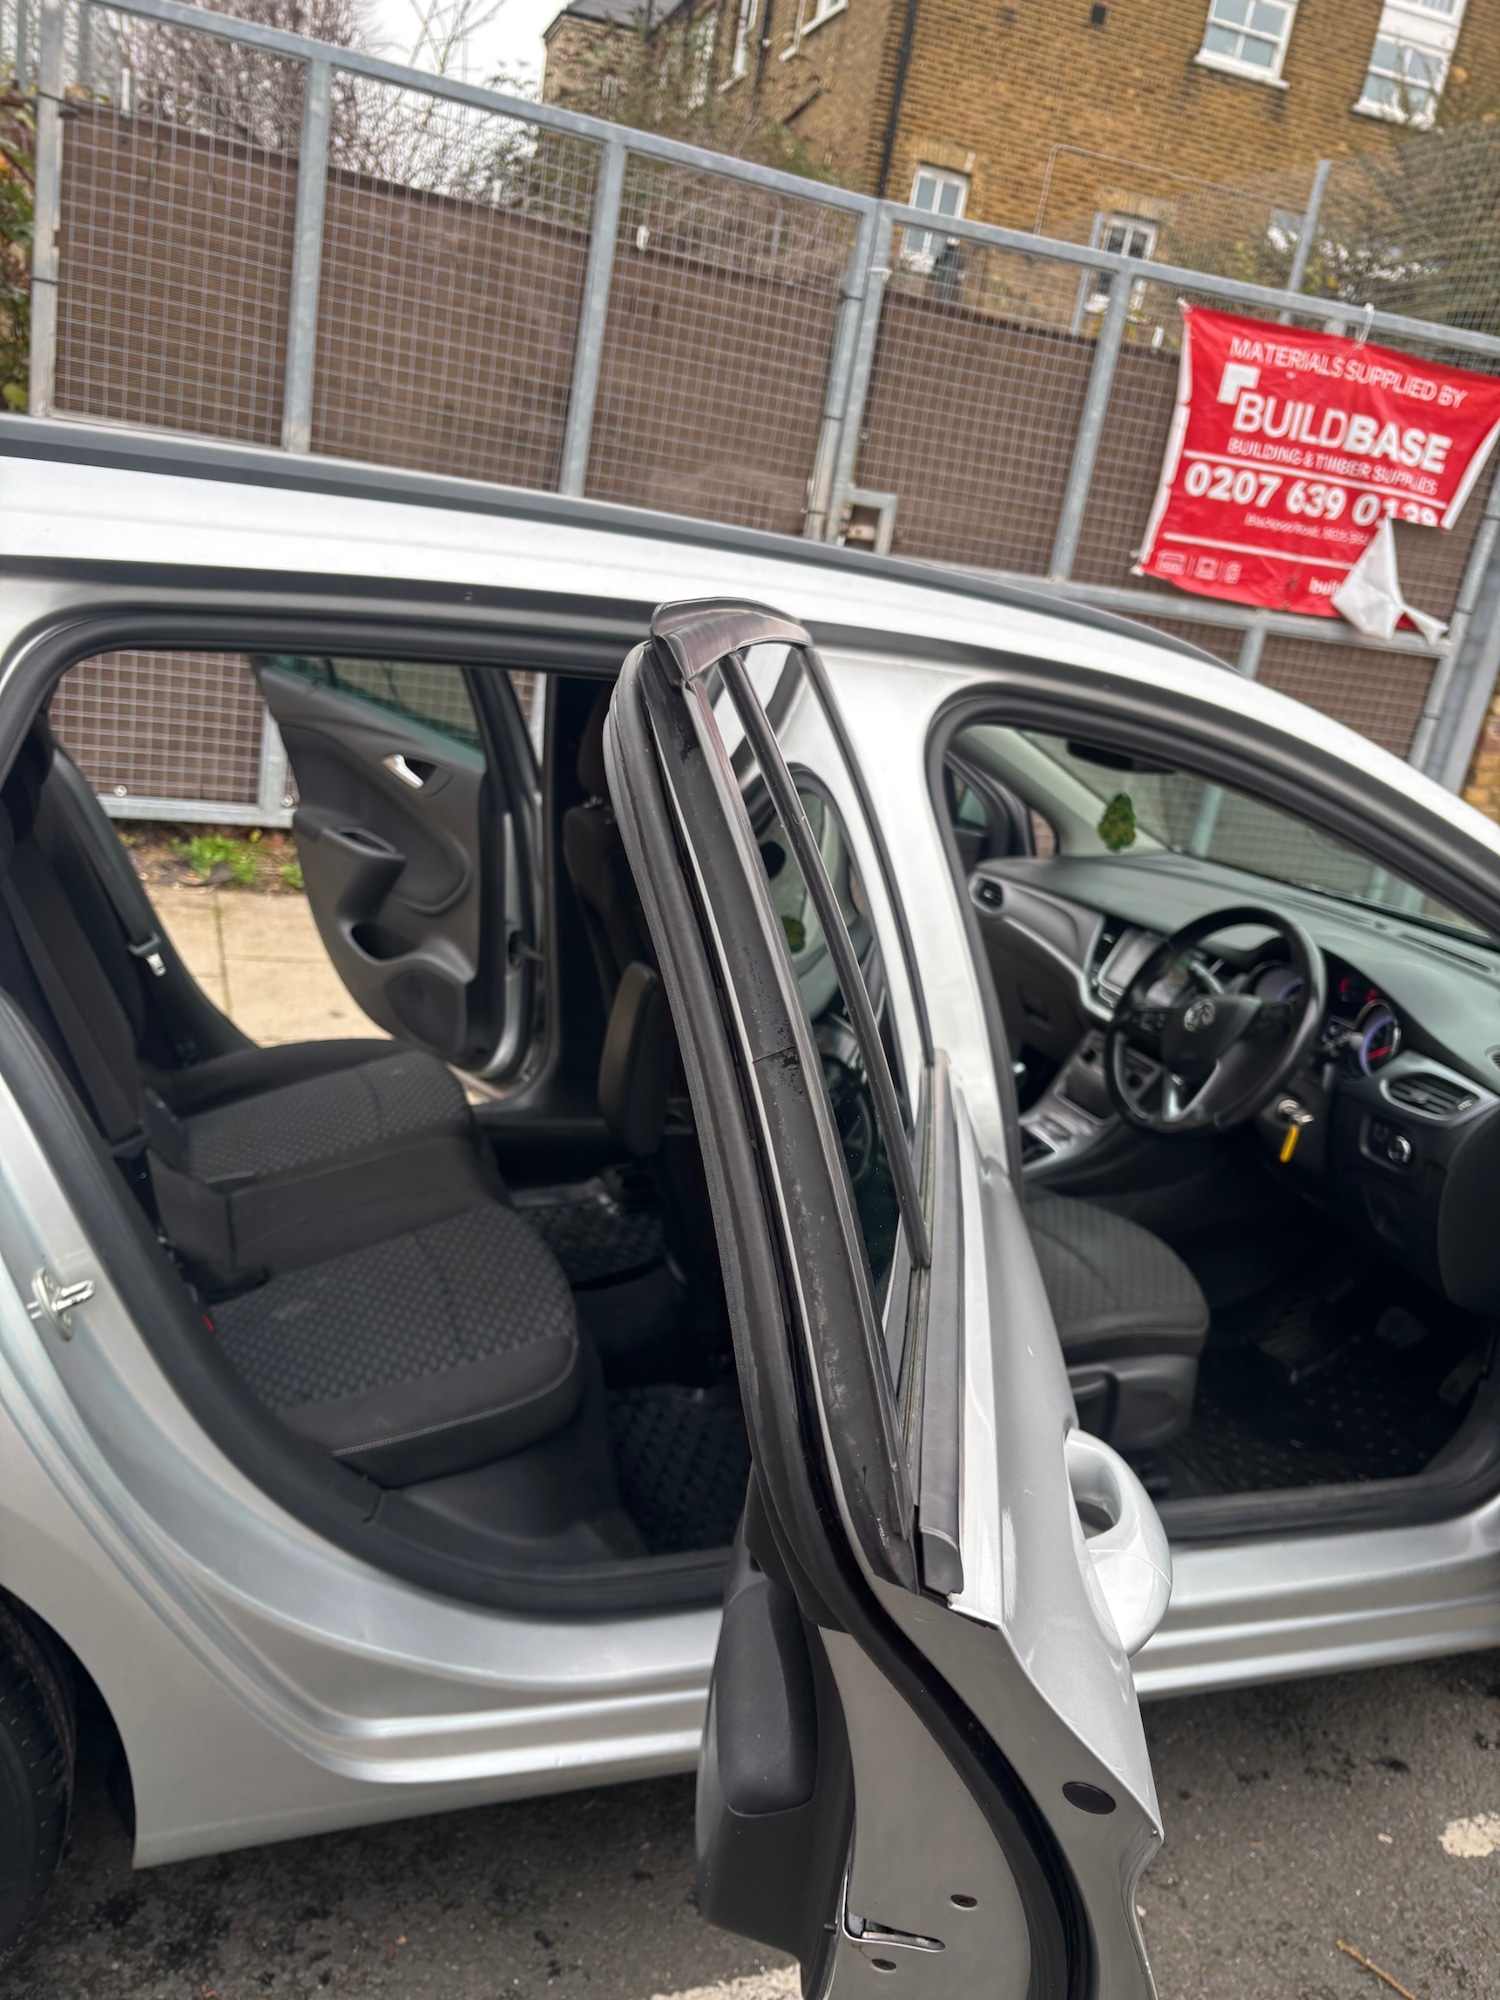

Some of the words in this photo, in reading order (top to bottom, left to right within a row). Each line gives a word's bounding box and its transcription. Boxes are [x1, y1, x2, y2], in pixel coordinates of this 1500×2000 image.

[1229, 337, 1345, 378] MATERIALS
[1344, 359, 1437, 401] SUPPLIED
[1437, 384, 1468, 409] BY
[1227, 436, 1303, 465] BUILDING
[1303, 452, 1315, 468] &
[1315, 454, 1372, 479] TIMBER
[1372, 464, 1438, 495] SUPPLIES
[1232, 391, 1453, 474] BUILDBASE
[1184, 460, 1283, 508] 0207
[1286, 479, 1347, 520] 639
